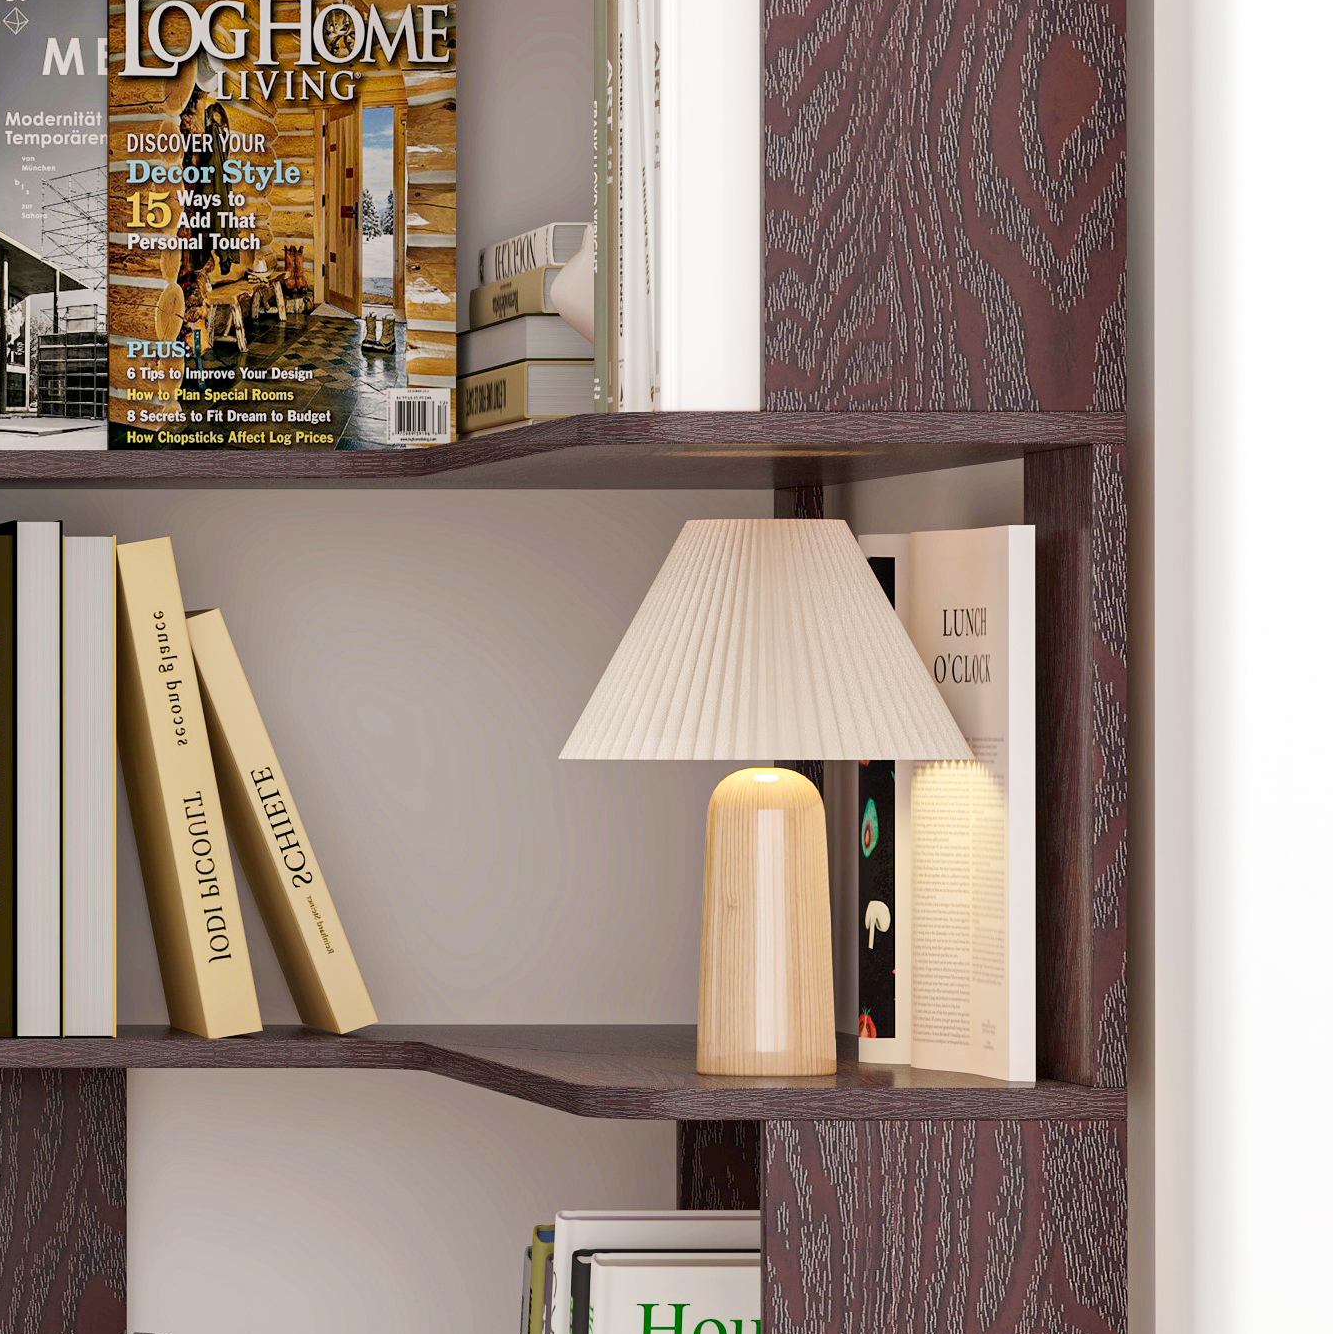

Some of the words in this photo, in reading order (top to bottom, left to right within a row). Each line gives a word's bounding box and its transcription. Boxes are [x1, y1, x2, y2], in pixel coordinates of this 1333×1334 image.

[127, 341, 190, 358] PLUS:
[127, 389, 154, 400] How
[158, 390, 170, 400] to
[174, 389, 200, 400] Plan
[205, 389, 247, 402] Special
[252, 389, 294, 400] Rooms
[127, 410, 135, 422] 8
[140, 410, 186, 422] Secrets
[191, 411, 202, 422] to
[207, 410, 223, 422] Fit
[228, 410, 266, 422] Dream
[271, 411, 283, 422] to
[288, 410, 331, 424] Budget
[127, 431, 153, 443] How
[158, 431, 223, 445] Chopsticks
[228, 431, 265, 443] Affect
[270, 431, 291, 445] Log
[296, 431, 333, 443] Prices
[942, 607, 987, 637] LUNCH
[933, 653, 990, 684] O'CLOCK
